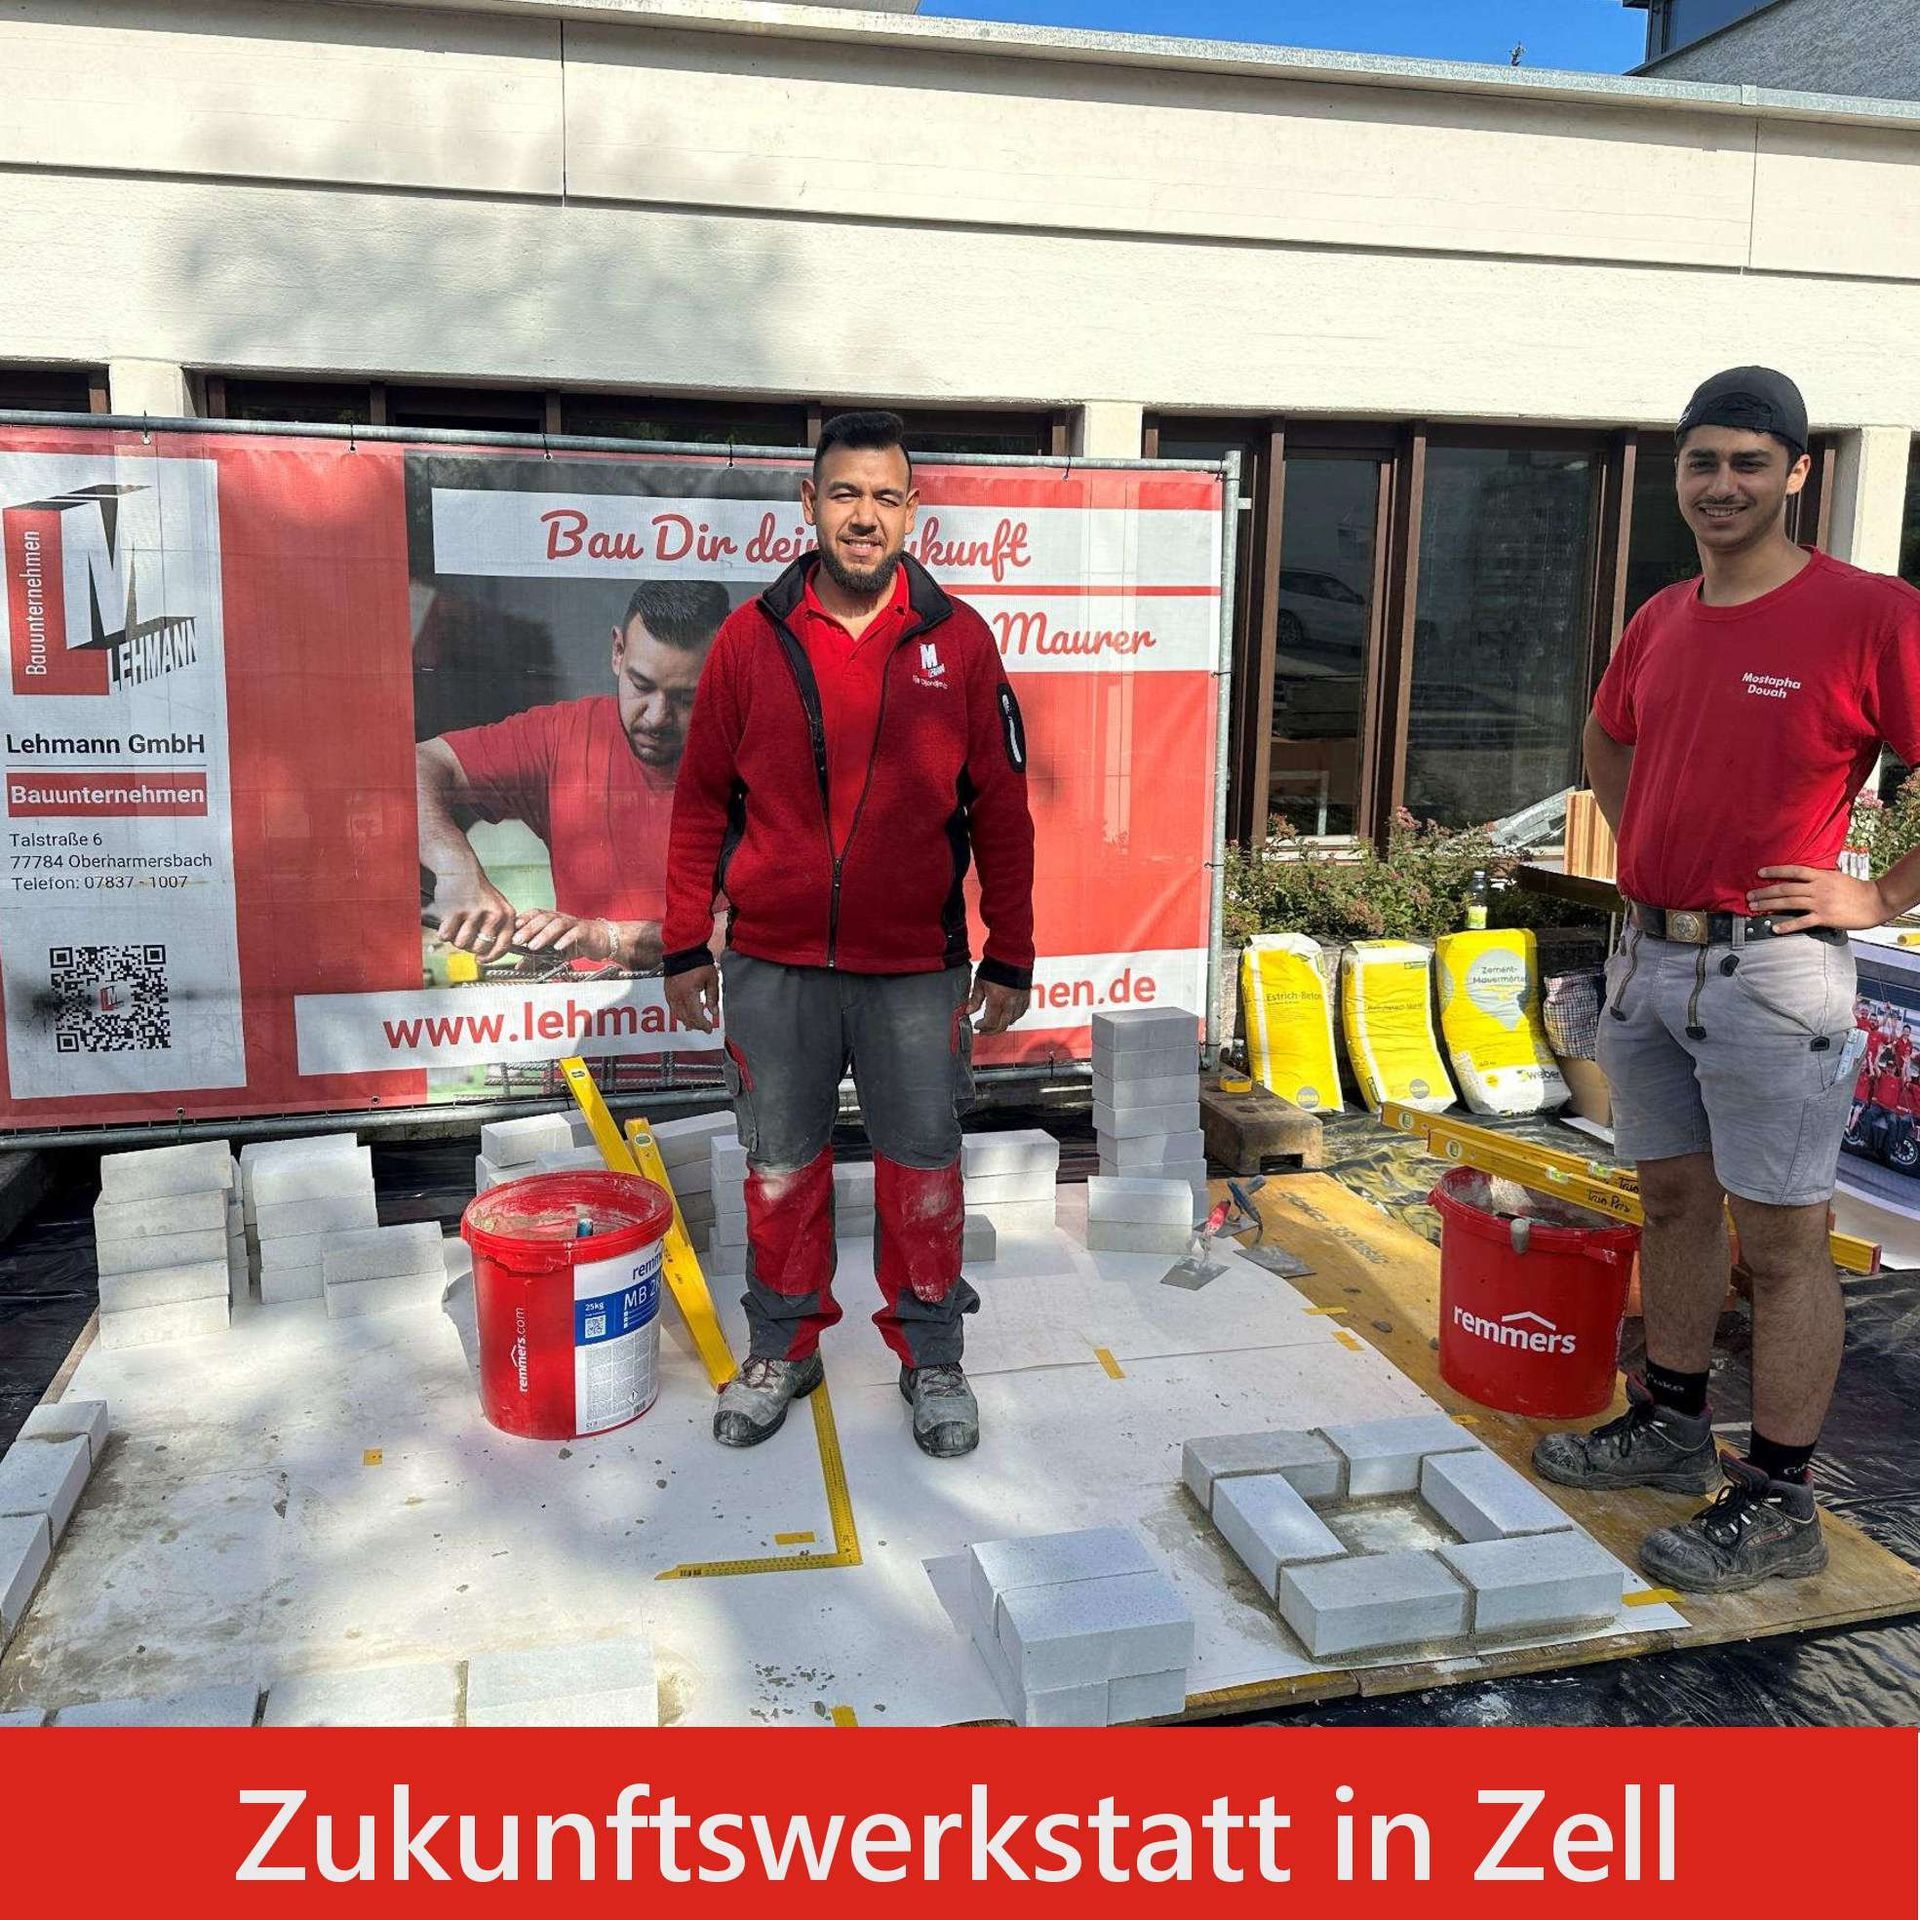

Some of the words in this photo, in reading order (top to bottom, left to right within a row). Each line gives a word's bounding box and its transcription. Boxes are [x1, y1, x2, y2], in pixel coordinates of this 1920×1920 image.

[540, 509, 643, 561] Bau
[651, 513, 737, 563] Dir
[19, 530, 47, 676] Bauunternehmen
[992, 611, 1156, 655] Maurer
[107, 618, 197, 692] LEHMANN
[1741, 672, 1801, 689] Mostapha
[1747, 684, 1787, 699] Douah
[6, 733, 120, 754] Lehmann
[128, 733, 205, 754] GmbH
[11, 785, 204, 804] Bauunternehmen
[9, 832, 88, 847] Talstraße
[93, 833, 103, 846] 6
[10, 855, 64, 869] 77784
[69, 853, 212, 869] Oberharmersbach
[12, 876, 80, 890] Telefon:
[85, 876, 135, 889] 07837
[149, 875, 188, 889] 1007
[585, 1301, 605, 1312] 25kg
[624, 1285, 648, 1311] MB
[1453, 1305, 1577, 1354] remmers
[516, 1307, 529, 1393] remmers.com
